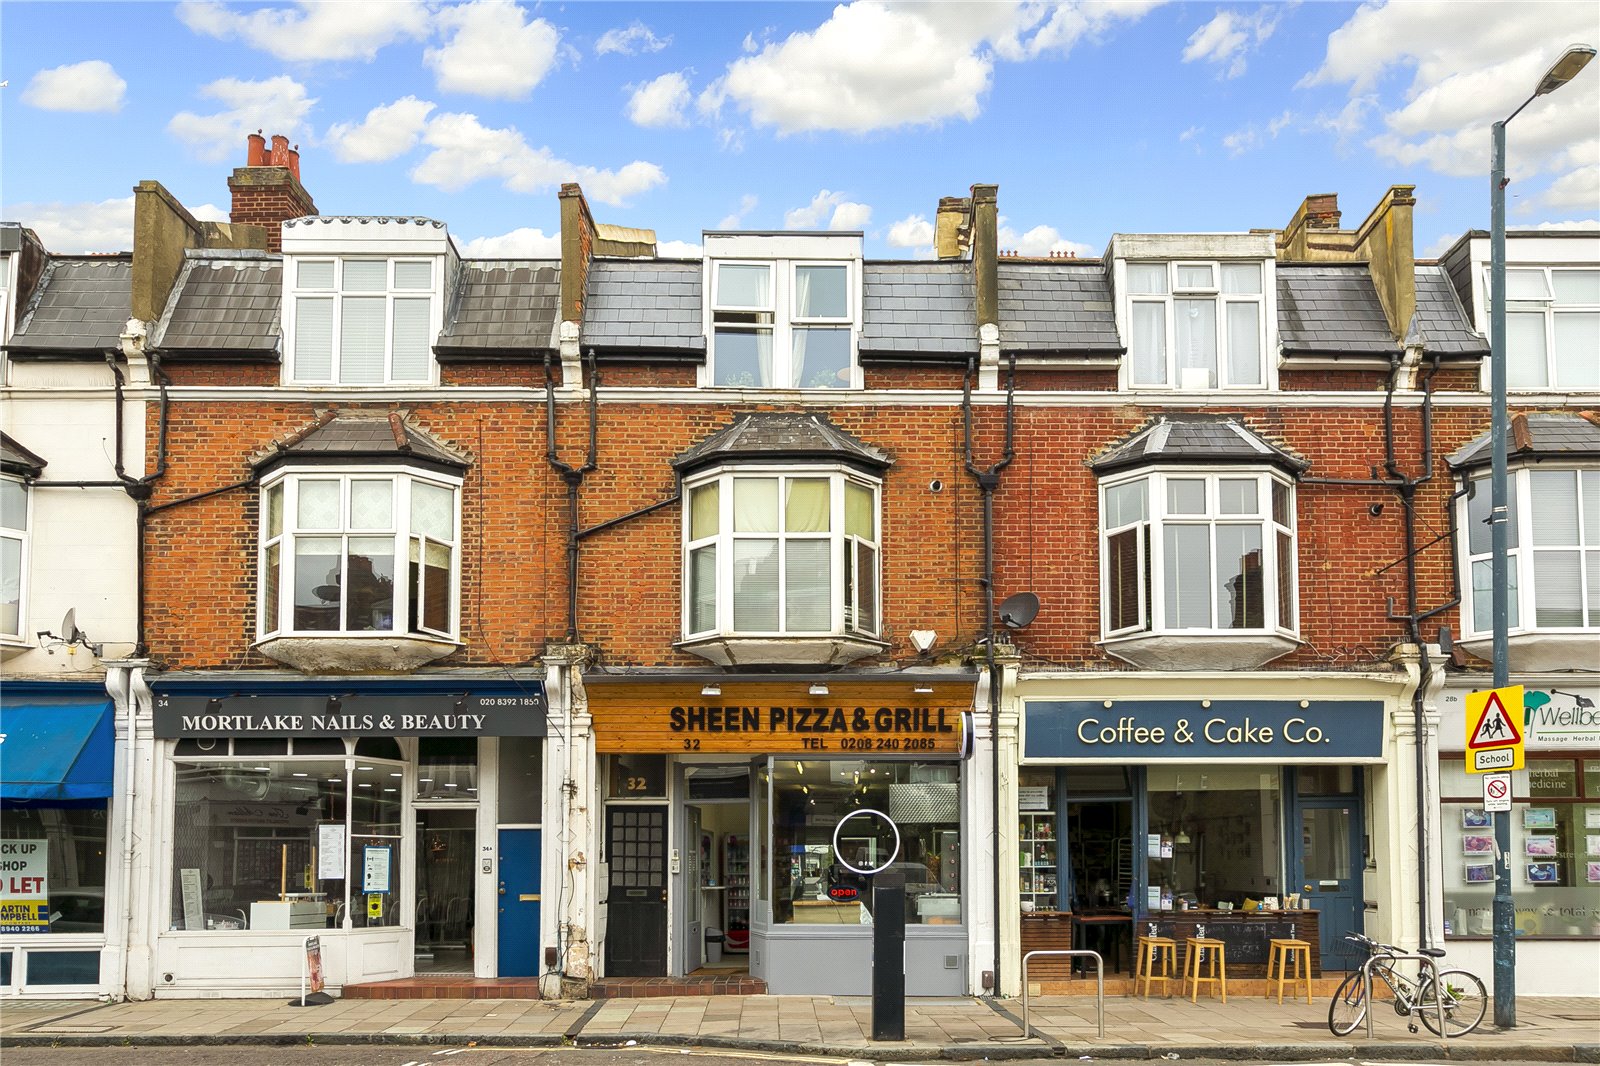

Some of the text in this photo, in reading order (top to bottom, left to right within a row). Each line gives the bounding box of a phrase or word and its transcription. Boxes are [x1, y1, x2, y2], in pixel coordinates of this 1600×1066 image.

[158, 699, 169, 707] 34
[480, 698, 496, 706] 020
[497, 698, 517, 706] 8392
[182, 714, 487, 731] MORTLAKE NAILS & BEAUTY
[670, 706, 953, 732] SHEEN PIZZA & GRILL
[1077, 717, 1330, 744] Coffee & Cake Co.
[683, 738, 701, 750] 32
[801, 738, 936, 750] TEL 0208 240 2085
[1479, 753, 1510, 764] School
[627, 777, 647, 790] 32
[21, 844, 37, 854] UP
[10, 877, 44, 893] LET
[831, 888, 857, 897] open
